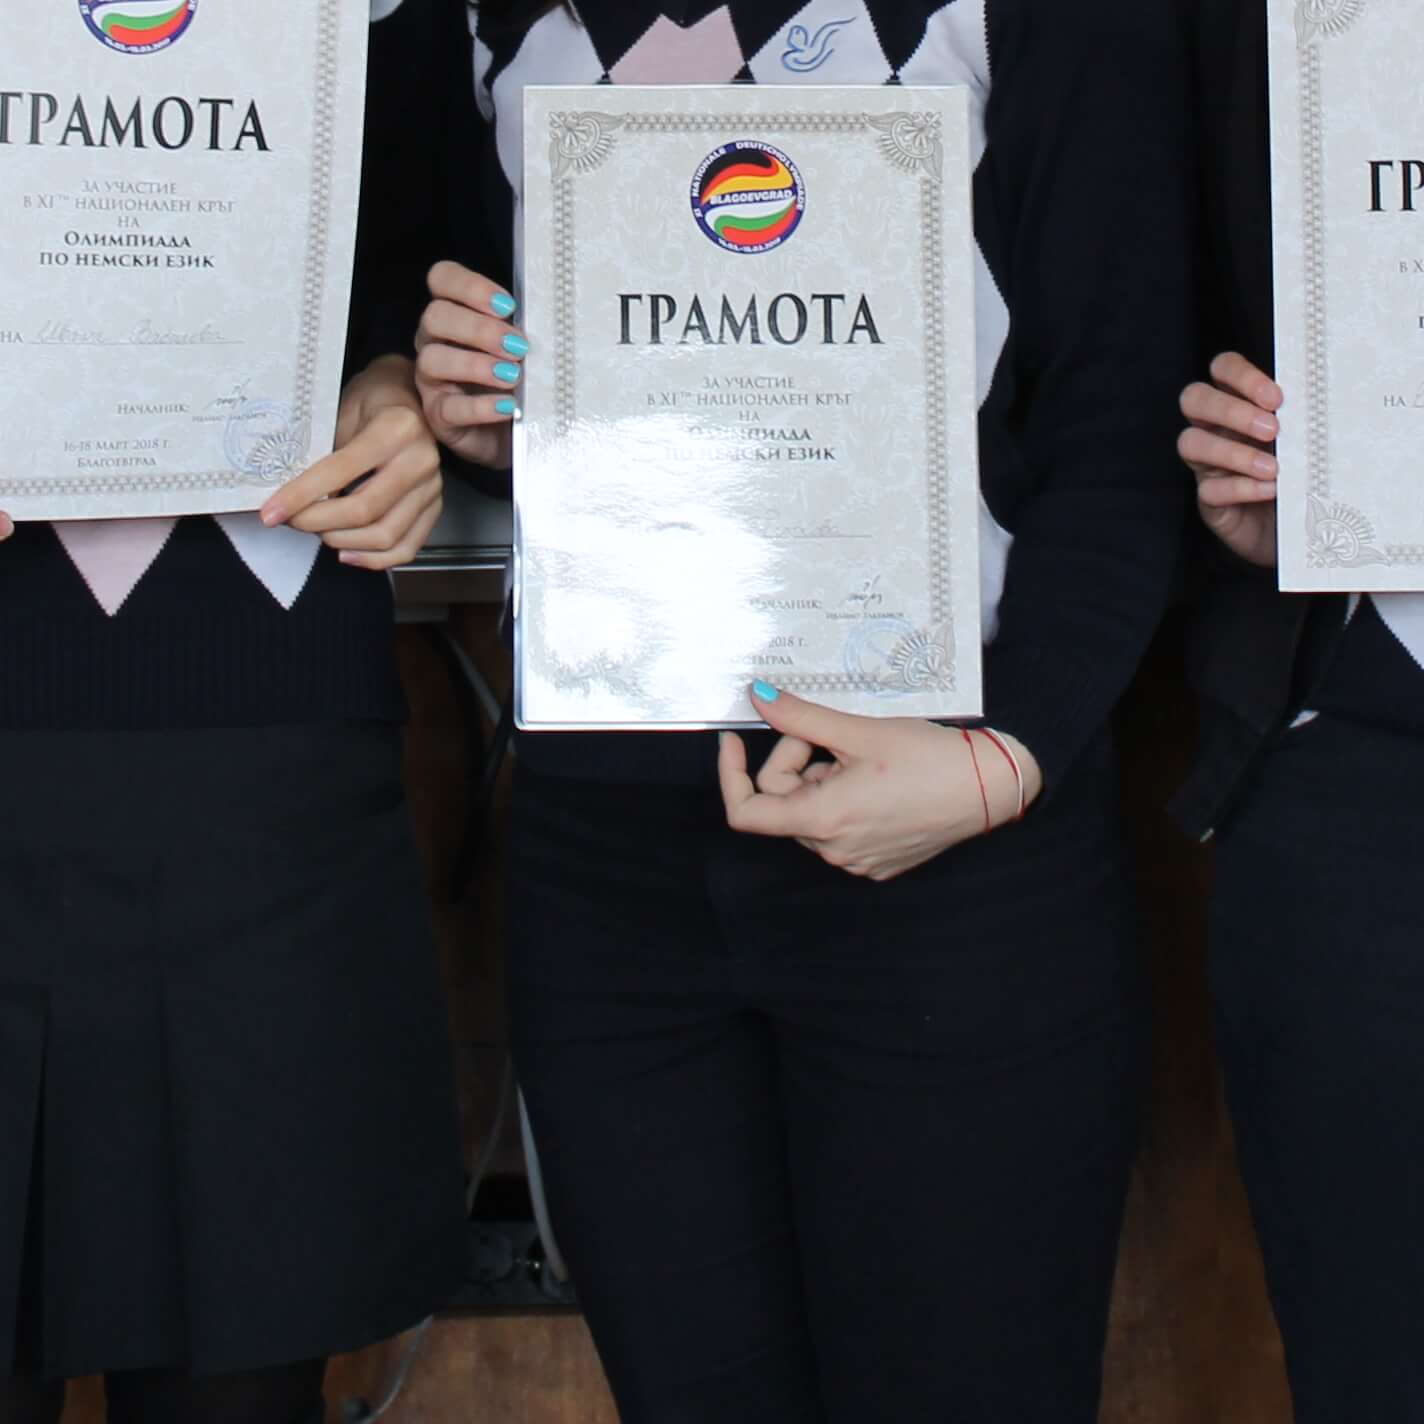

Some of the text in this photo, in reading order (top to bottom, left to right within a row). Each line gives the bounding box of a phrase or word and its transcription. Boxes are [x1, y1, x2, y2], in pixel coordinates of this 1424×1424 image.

[692, 147, 727, 197] NATIONALE
[82, 180, 177, 195] ЗА УЧАСТИЕ
[23, 196, 32, 208] В
[74, 196, 191, 213] НАЦИОНАЛЕН
[197, 200, 236, 213] КРЪГ
[710, 190, 793, 205] BLAGOEVGRAD
[117, 216, 141, 228] НА
[40, 252, 216, 269] ПО НЕМСКИ ЕЗИК
[1399, 261, 1408, 273] В
[616, 291, 885, 346] ГРАМОТА
[0, 331, 24, 343] НА
[704, 376, 796, 389] ЗА УЧАСТИЕ
[647, 394, 656, 406] В
[697, 393, 808, 406] НАЦИОНАЛЕН
[815, 392, 852, 406] КРЪГ
[1383, 395, 1407, 408] НА
[739, 411, 761, 422] НА
[787, 447, 836, 461] ЕЗИК
